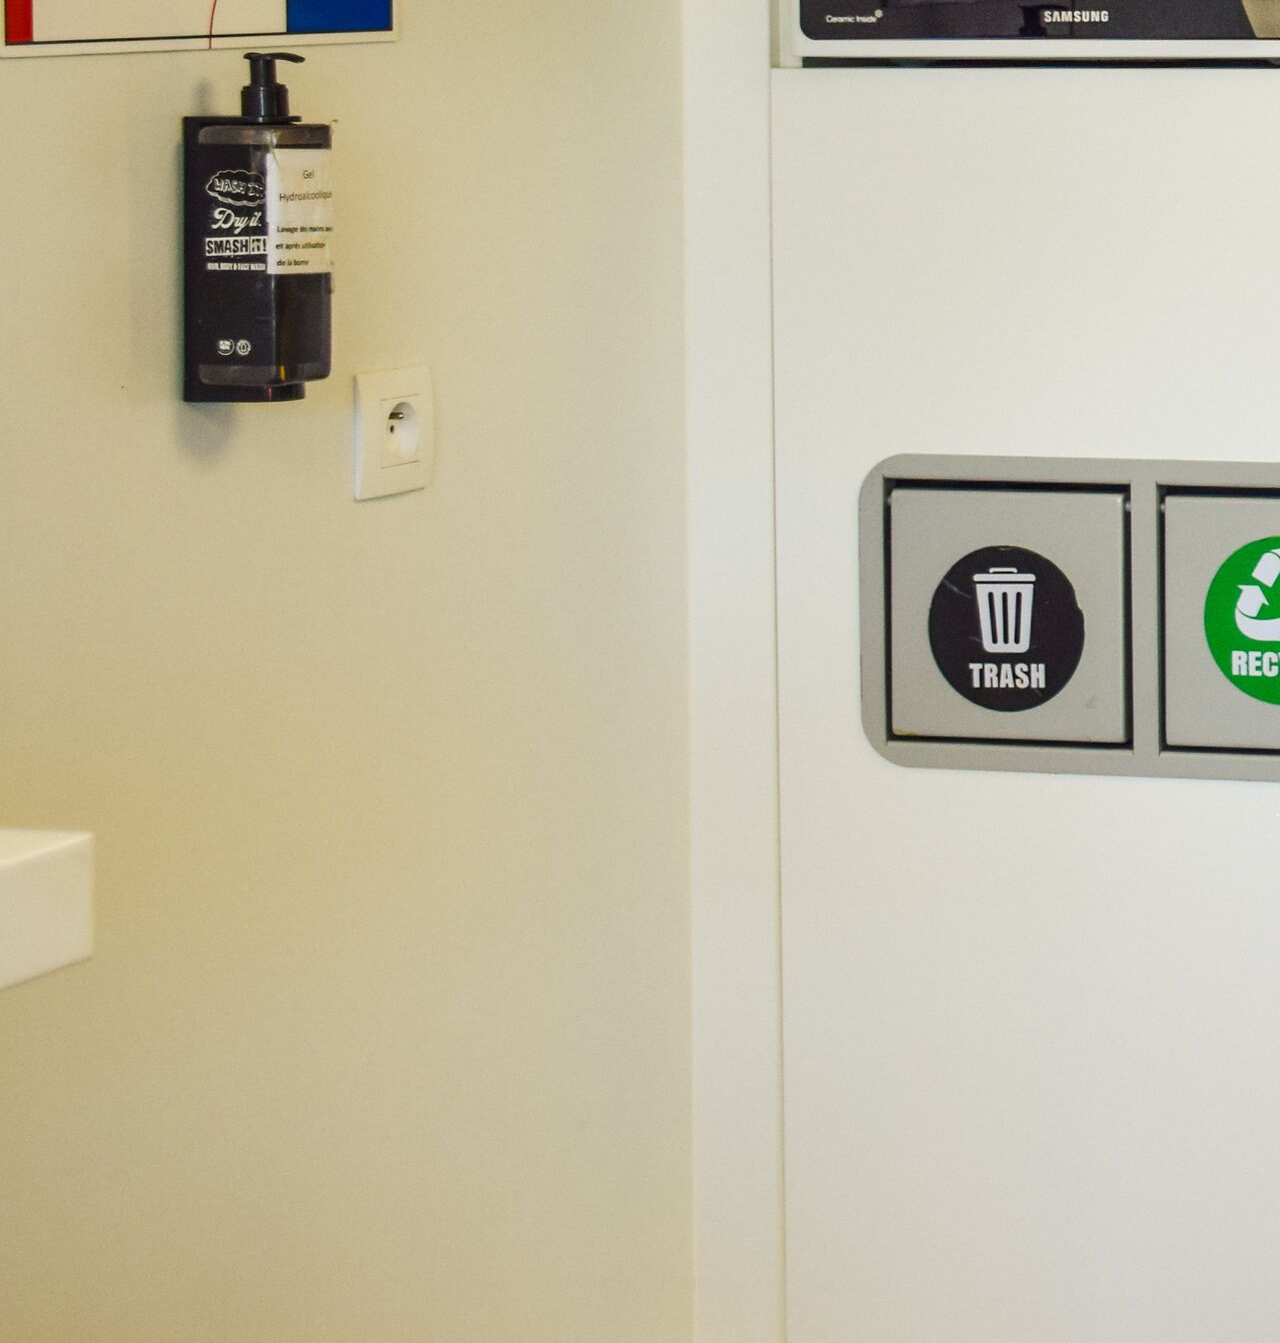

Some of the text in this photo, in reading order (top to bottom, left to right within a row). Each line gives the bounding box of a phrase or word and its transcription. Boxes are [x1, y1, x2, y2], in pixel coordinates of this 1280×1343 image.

[1043, 10, 1110, 23] SAMSUNG
[302, 169, 315, 180] Gel
[206, 239, 249, 255] SMASH
[968, 661, 1046, 690] TRASH
